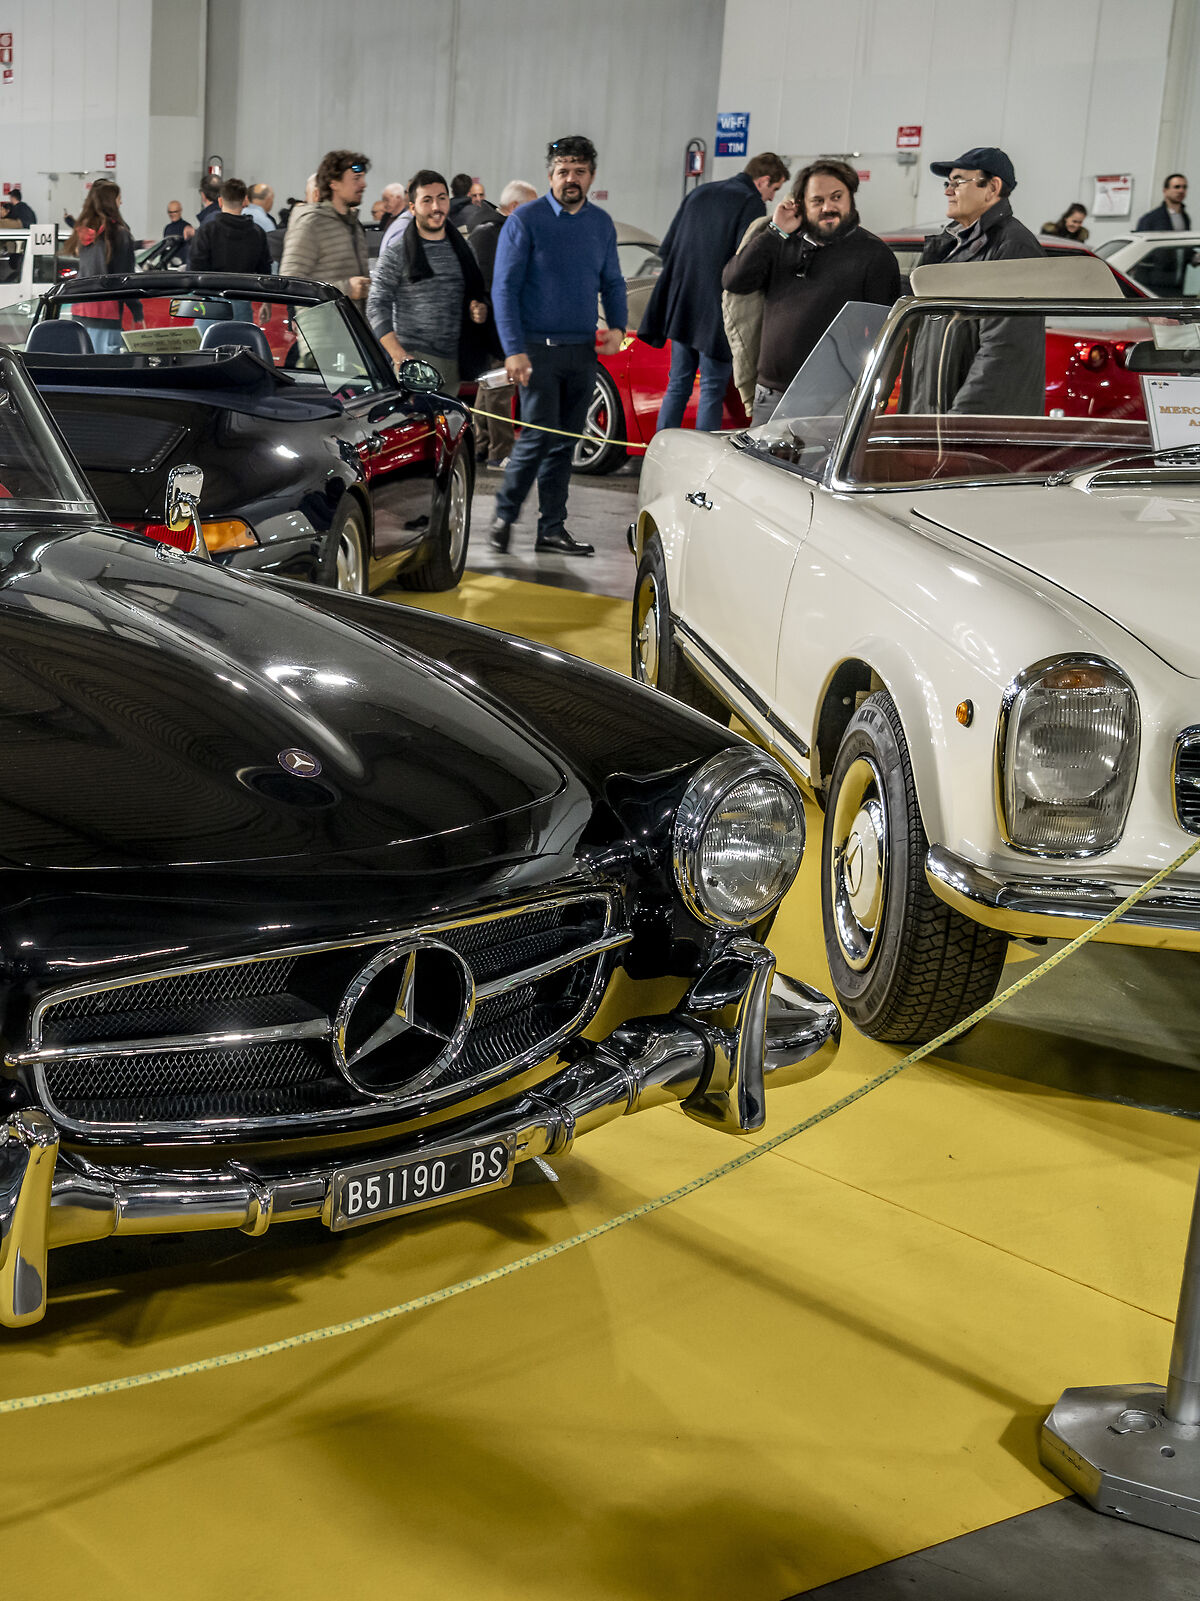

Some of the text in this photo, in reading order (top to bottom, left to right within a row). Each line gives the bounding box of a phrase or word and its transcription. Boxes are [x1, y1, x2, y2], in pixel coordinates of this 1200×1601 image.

[721, 116, 746, 129] Wi-Fi
[728, 143, 744, 152] TIM
[35, 233, 51, 245] L04
[1159, 405, 1200, 415] MERC
[348, 1146, 504, 1215] B51190 BS
